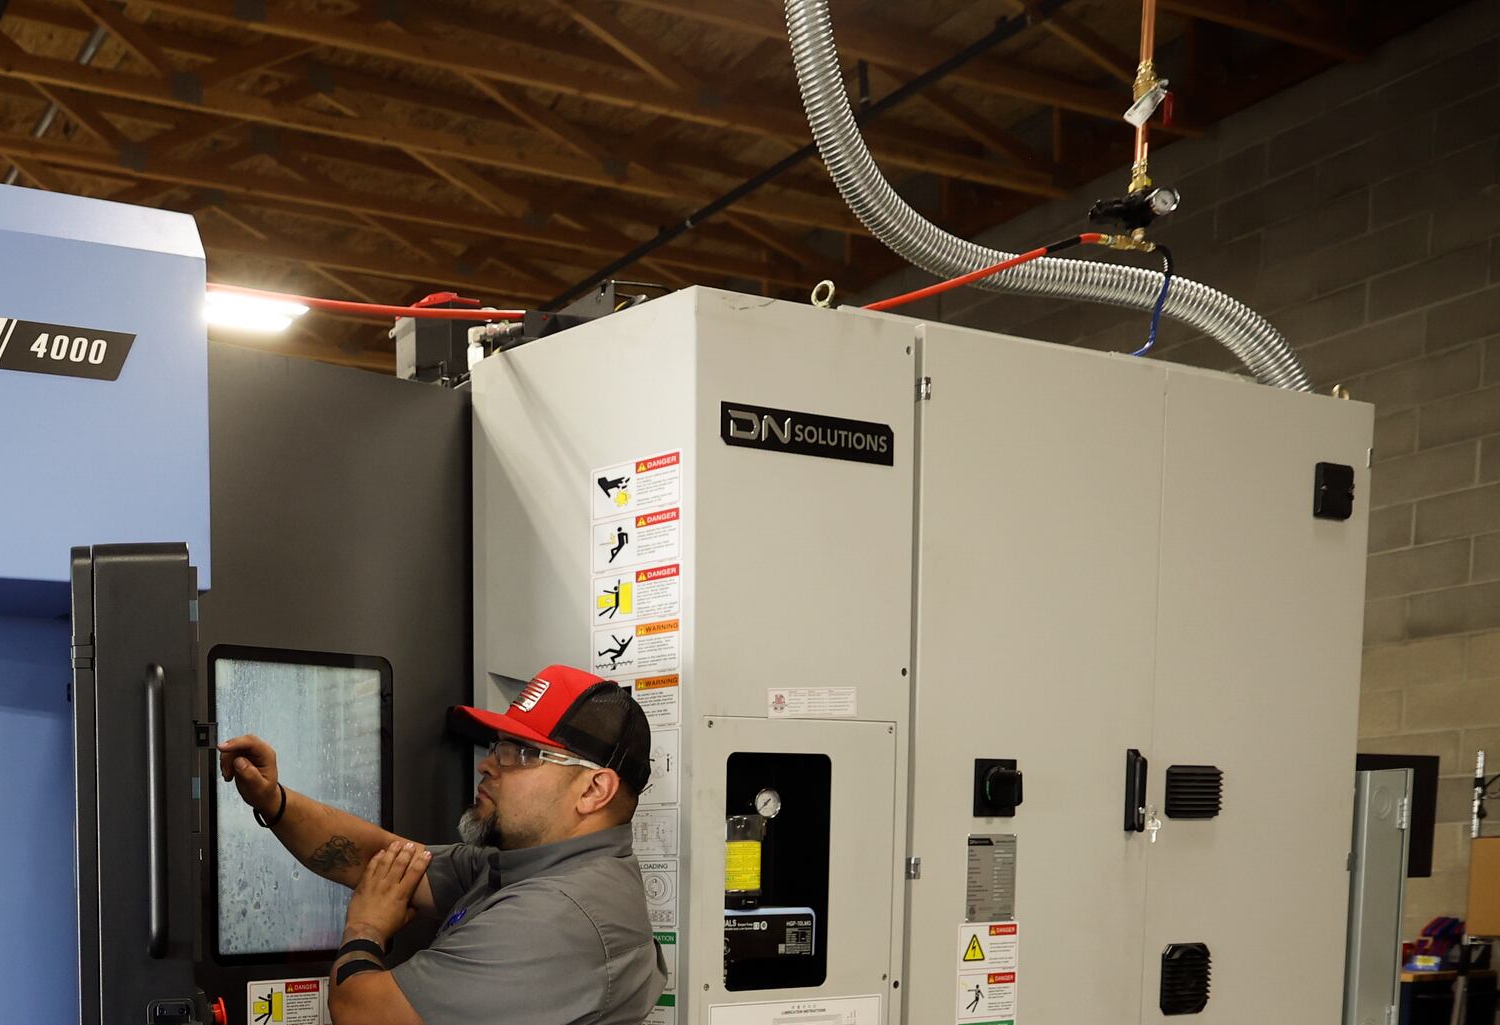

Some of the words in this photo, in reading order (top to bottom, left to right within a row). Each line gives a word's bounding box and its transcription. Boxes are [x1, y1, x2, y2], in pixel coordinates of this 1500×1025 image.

[30, 332, 108, 365] 4000
[728, 408, 791, 445] DN
[794, 423, 888, 453] SOLUTIONS
[646, 455, 677, 469] DANGER
[646, 511, 677, 524] DANGER
[646, 567, 677, 579] DANGER
[645, 622, 679, 633] WARNING
[645, 676, 678, 687] WARNING
[640, 862, 669, 870] LOADING
[996, 926, 1016, 934] DANGER
[294, 983, 318, 991] DANGER
